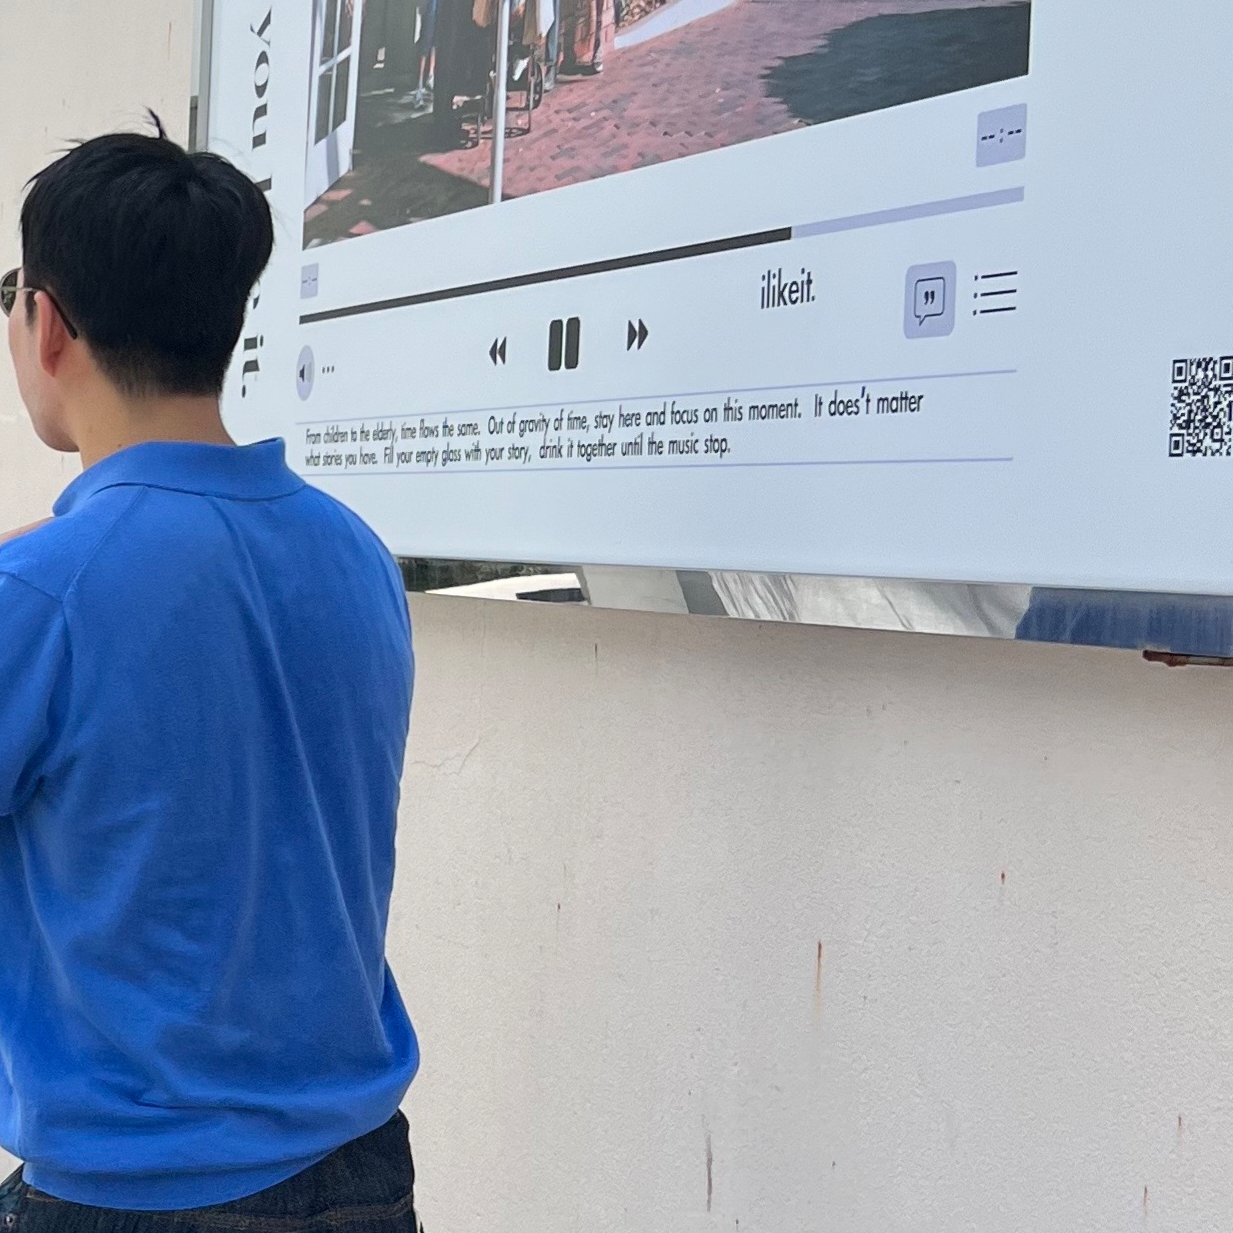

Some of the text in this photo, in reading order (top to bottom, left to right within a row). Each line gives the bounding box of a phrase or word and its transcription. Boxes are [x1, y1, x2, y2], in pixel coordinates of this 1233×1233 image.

[760, 267, 816, 310] ilikeit.
[305, 386, 925, 445] From children to the elderly, time flows the same. Out of gravity of time, stay here and focus on this moment. It does't matter
[305, 432, 731, 470] what stories you have. Fill your empty glass with your story, drink it together until the music stop.
